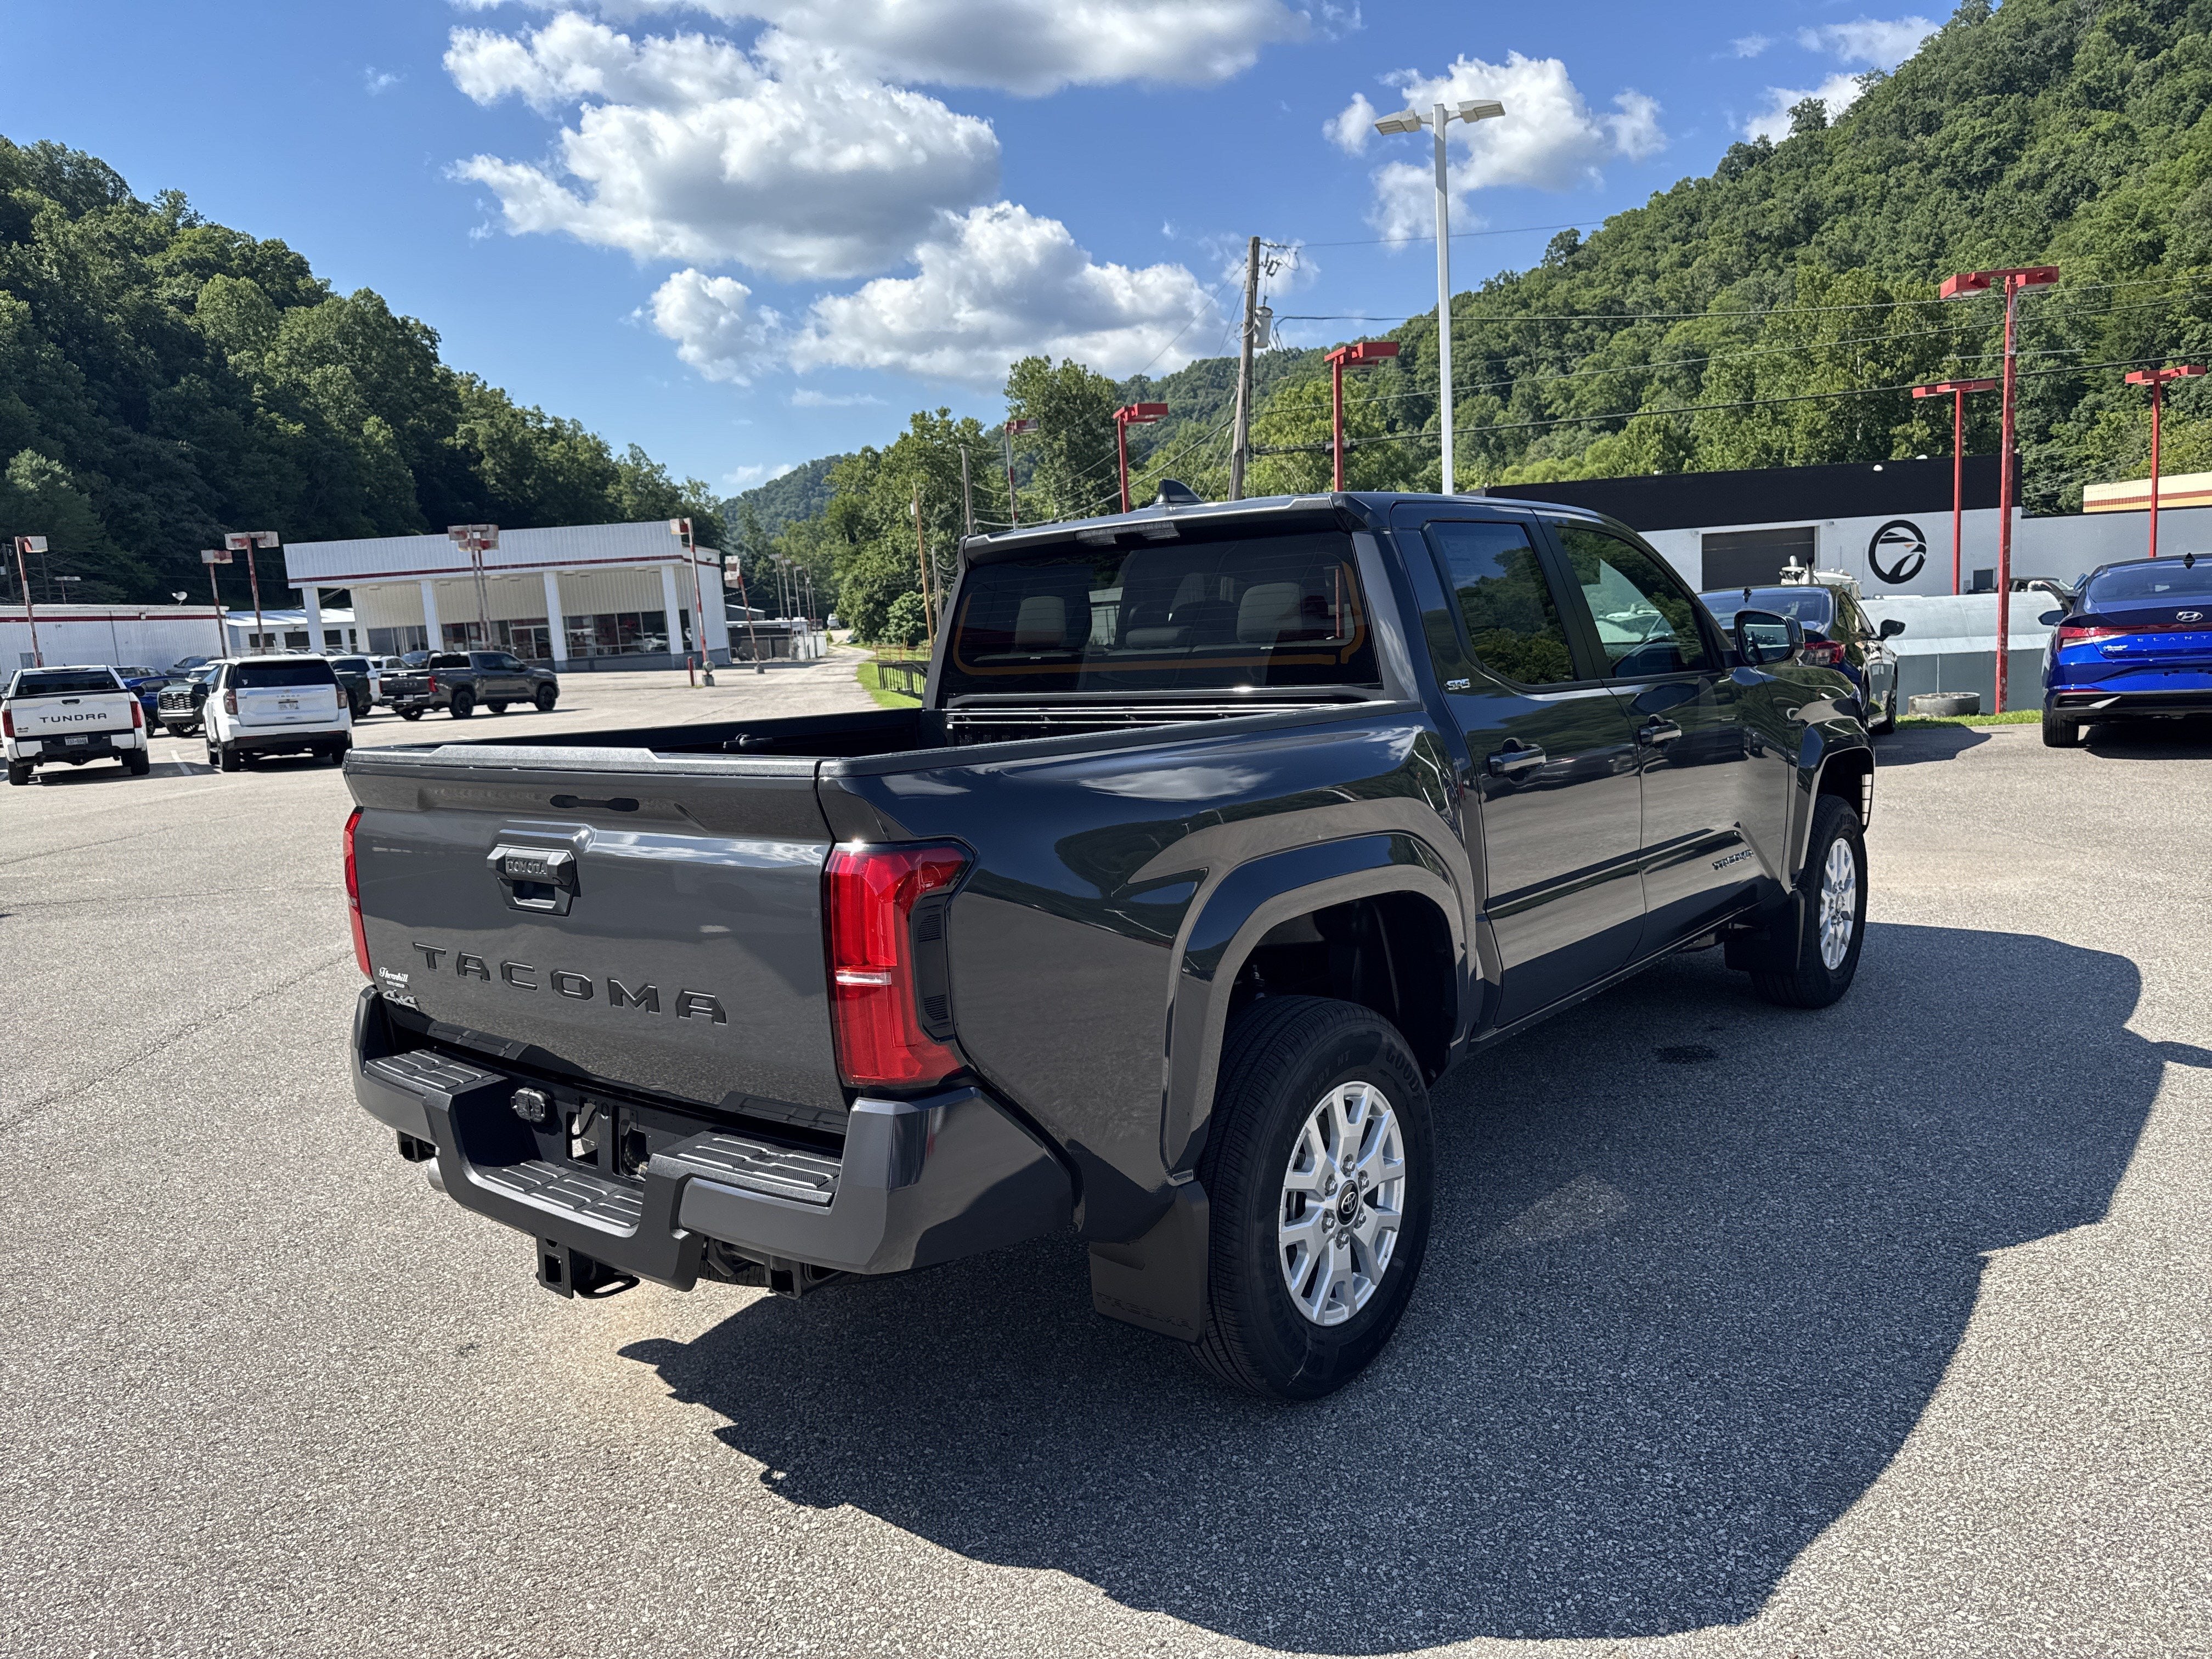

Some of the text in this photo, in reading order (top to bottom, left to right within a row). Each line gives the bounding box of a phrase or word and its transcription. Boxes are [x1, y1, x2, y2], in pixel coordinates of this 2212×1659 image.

[1445, 678, 1471, 690] SR5
[40, 713, 107, 723] TUNDRA
[506, 859, 547, 875] TOYOTA
[412, 941, 727, 1024] TACOMA
